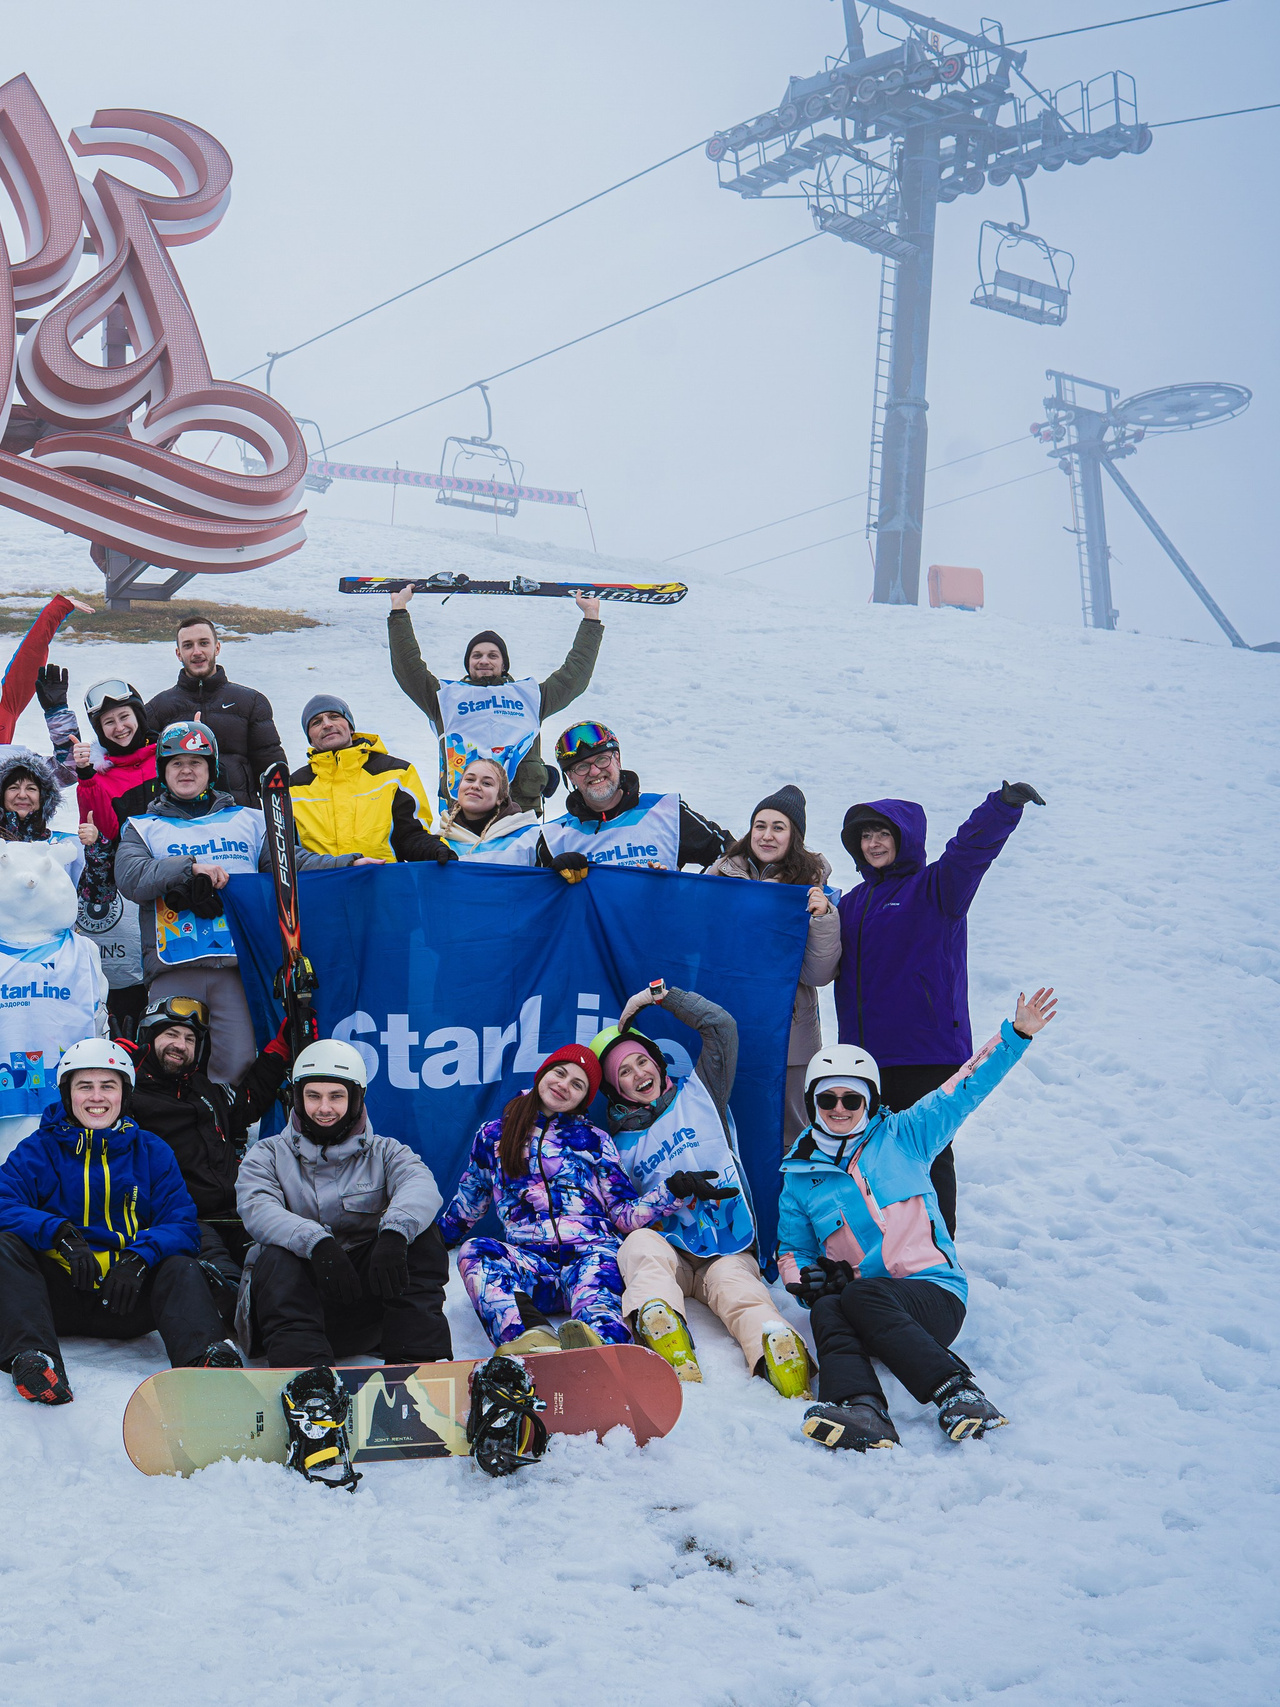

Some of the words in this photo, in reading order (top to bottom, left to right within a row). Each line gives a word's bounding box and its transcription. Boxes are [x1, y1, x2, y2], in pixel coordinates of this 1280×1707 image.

[457, 695, 524, 715] StarLine
[167, 838, 249, 857] StarLine
[271, 793, 290, 887] FISCHER
[585, 843, 658, 864] tarLine
[77, 899, 104, 930] JEANSWE
[100, 942, 126, 959] IN'S
[330, 992, 695, 1090] StarLie
[634, 1127, 696, 1182] StarLine
